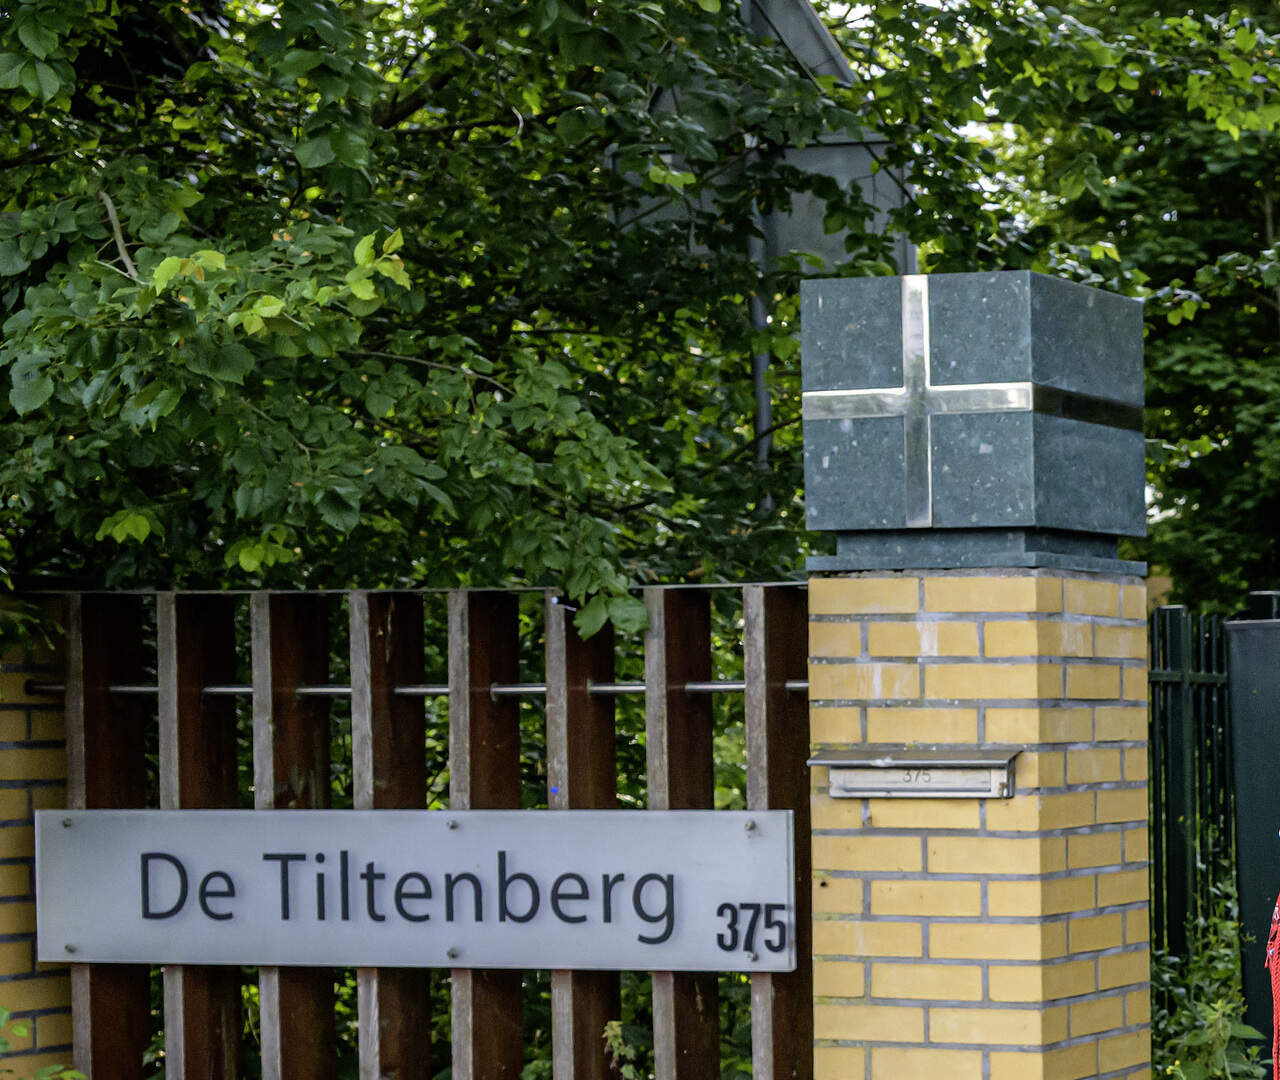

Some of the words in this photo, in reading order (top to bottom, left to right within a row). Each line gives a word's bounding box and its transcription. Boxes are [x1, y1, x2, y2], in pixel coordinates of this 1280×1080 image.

[902, 768, 932, 783] 375
[140, 851, 237, 922] De
[262, 850, 677, 945] Tiltenberg
[716, 902, 787, 953] 375
